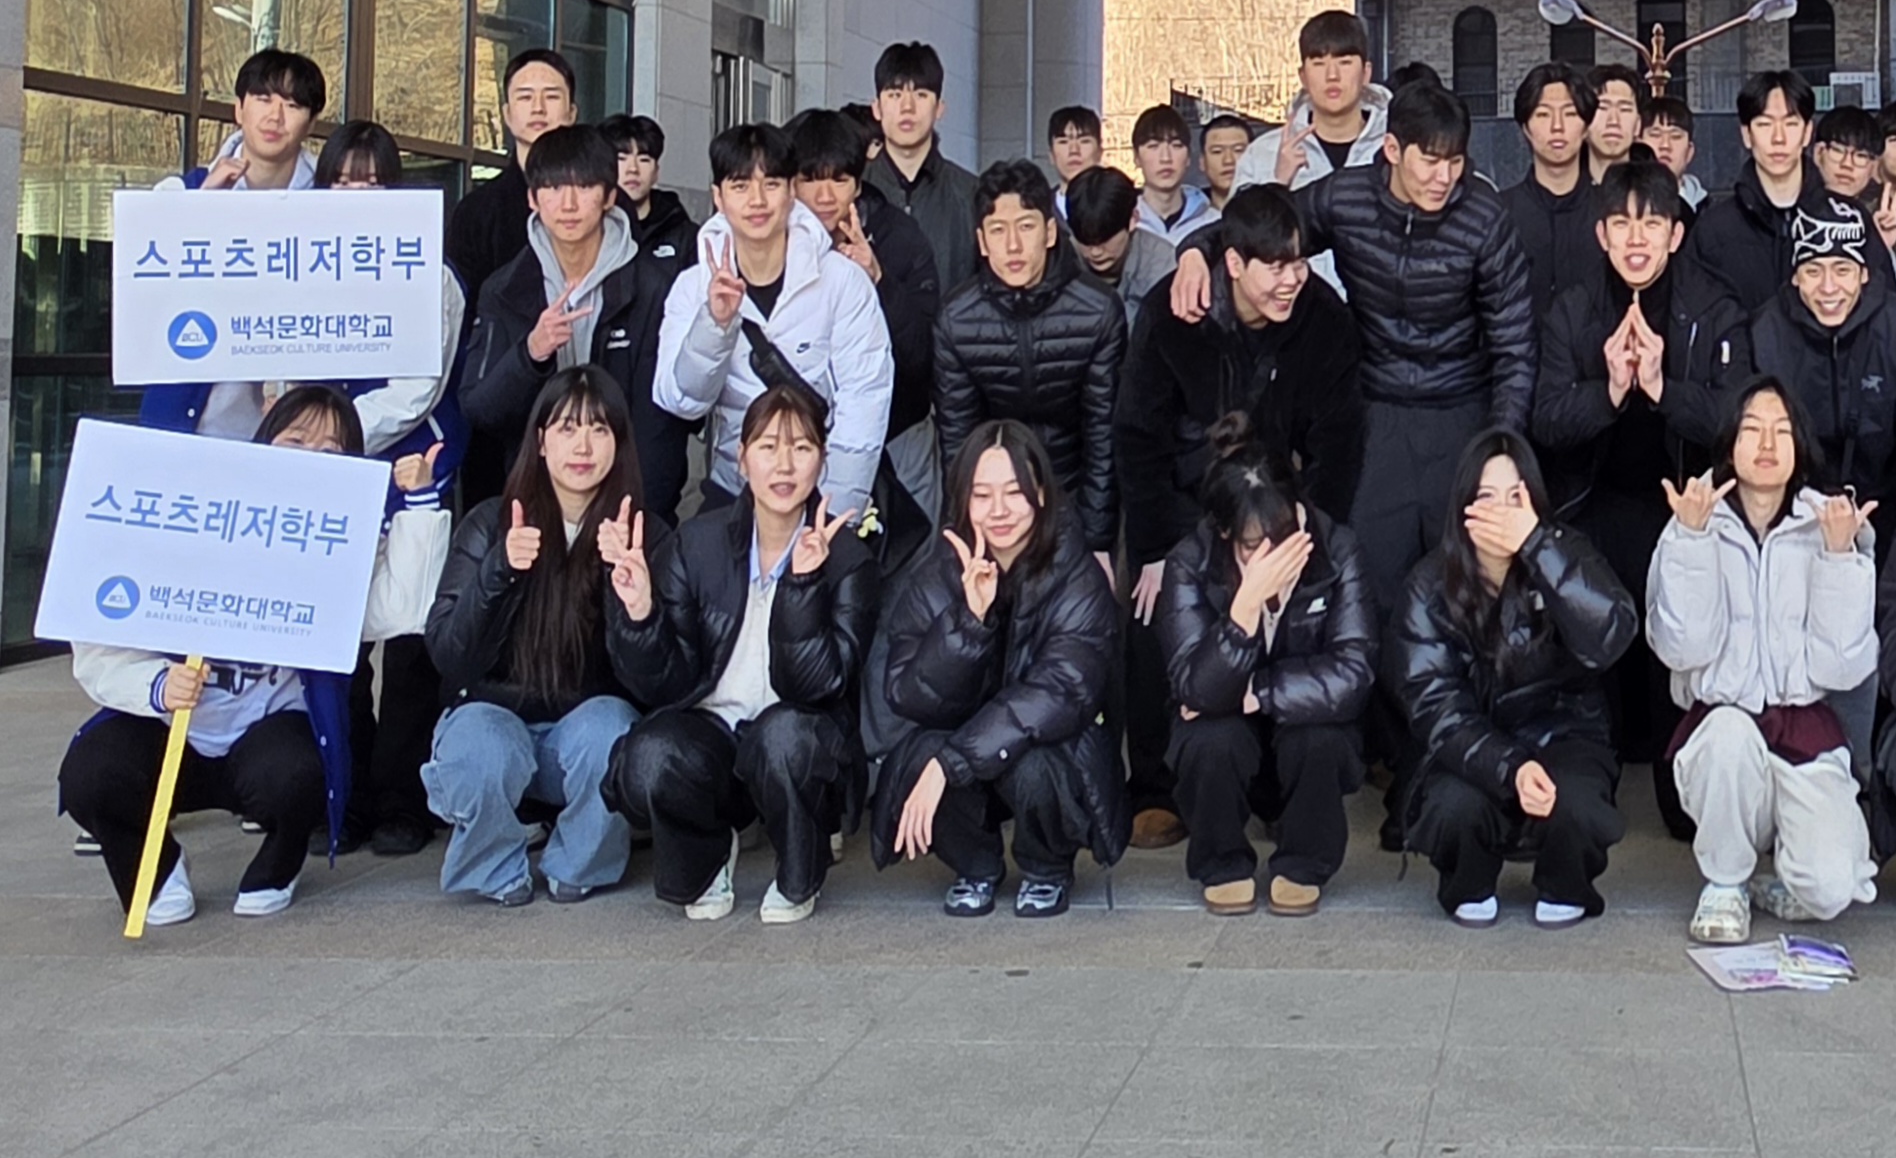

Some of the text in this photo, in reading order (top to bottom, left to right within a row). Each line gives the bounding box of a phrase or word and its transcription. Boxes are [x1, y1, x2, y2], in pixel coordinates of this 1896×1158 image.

[133, 235, 426, 282] 스포츠레저학부
[230, 314, 393, 340] 백석문화대학교
[231, 342, 391, 356] BAEKSEOK CULTURE UNIVERSITY
[85, 484, 349, 556] 스포츠레저학부
[149, 584, 315, 625] 백석문화대학교
[145, 610, 312, 637] BAEKSEOK CULTURE UNIVERSITY
